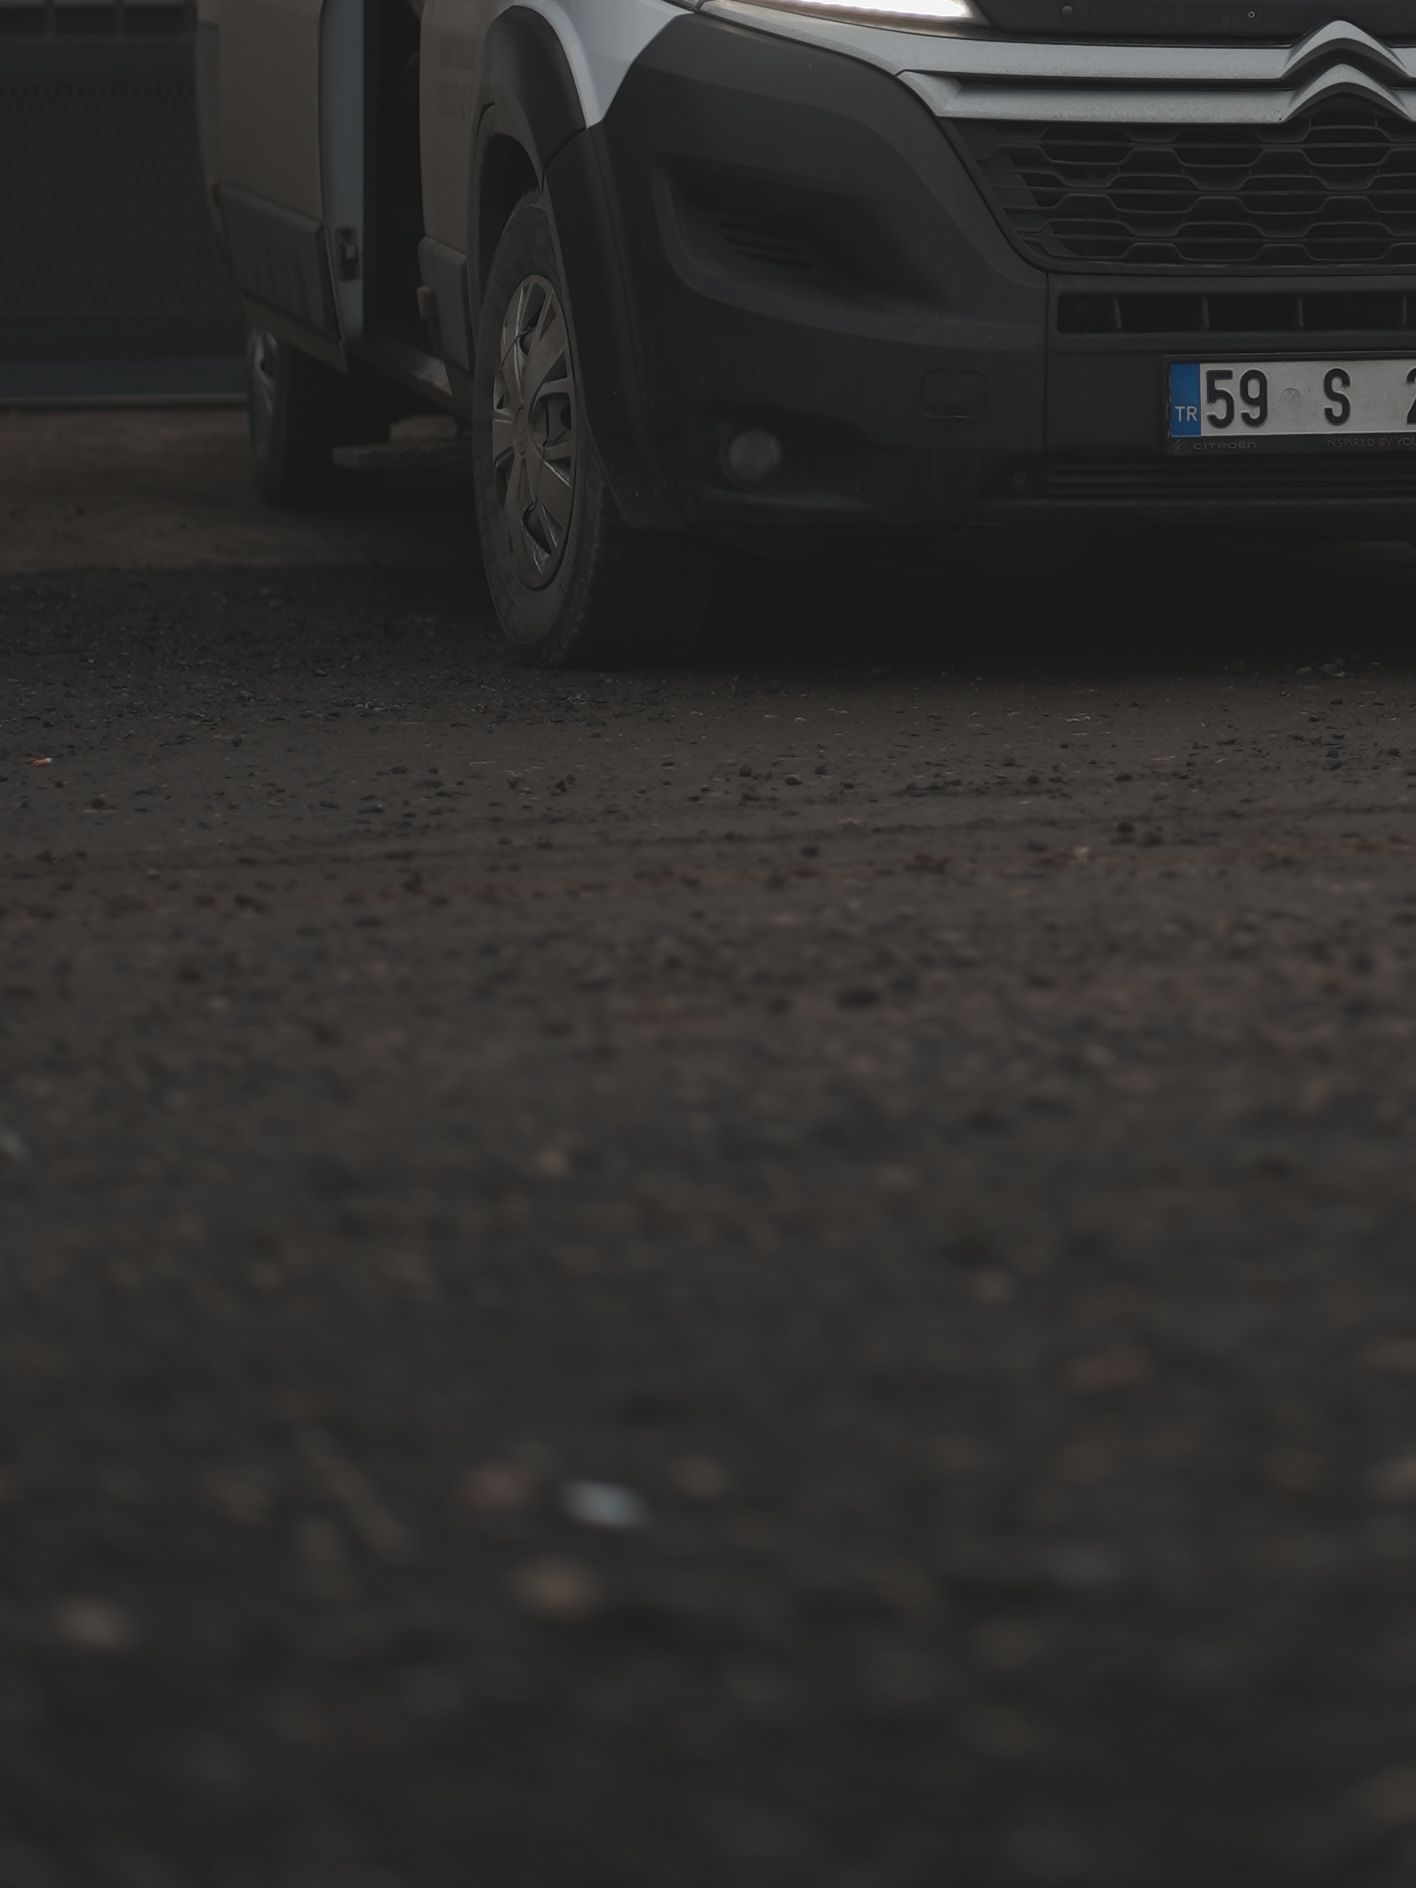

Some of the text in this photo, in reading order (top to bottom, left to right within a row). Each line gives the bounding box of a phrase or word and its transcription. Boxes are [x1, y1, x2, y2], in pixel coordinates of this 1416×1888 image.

[1175, 406, 1198, 423] TR
[1205, 368, 1269, 428] 59
[1322, 367, 1352, 426] S
[1377, 437, 1393, 448] BY
